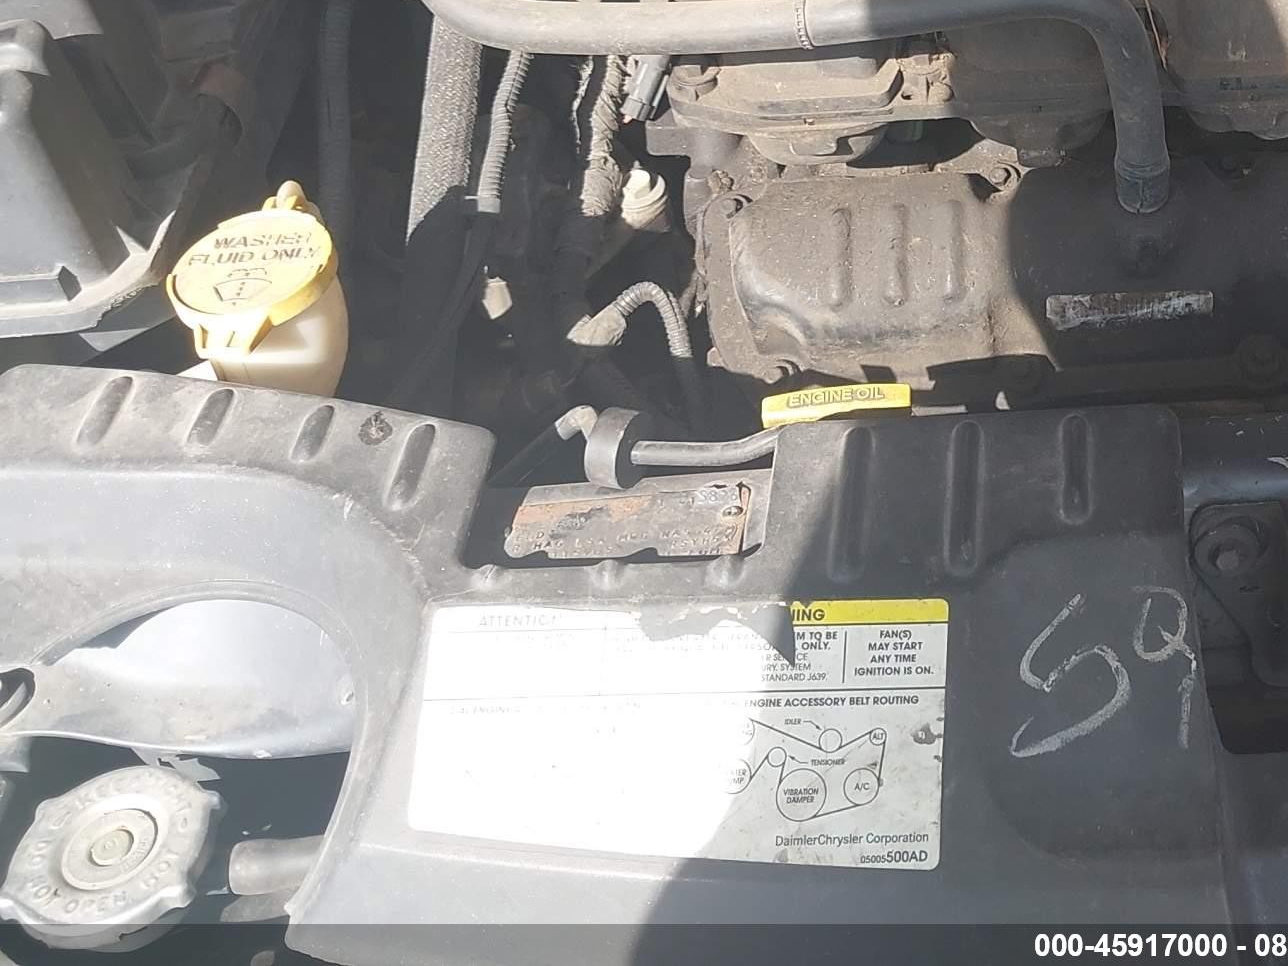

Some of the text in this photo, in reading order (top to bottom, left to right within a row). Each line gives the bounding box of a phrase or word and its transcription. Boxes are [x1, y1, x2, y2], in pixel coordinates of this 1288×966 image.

[214, 232, 312, 250] WASHER
[188, 246, 321, 266] FLUID ONLY
[786, 386, 885, 409] ENGINE OIL
[808, 631, 823, 641] TO
[825, 631, 838, 641] BE
[879, 629, 912, 641] FAN(S)
[801, 641, 831, 651] ONLY.
[868, 640, 923, 651] MAY START
[870, 653, 917, 664] ANY TIME
[854, 665, 935, 677] IGNITION IS ON.
[761, 673, 805, 682] STANDARD
[744, 697, 782, 708] ENGINE
[784, 696, 847, 708] ACCESSORY
[849, 695, 870, 706] BELT
[872, 694, 919, 706] ROUTING
[784, 718, 802, 726] IDLER
[872, 732, 884, 741] ALT
[810, 758, 846, 767] TENSIONER
[783, 787, 819, 796] VIBRATION
[854, 781, 870, 792] A/C
[786, 795, 815, 804] DAMPER
[775, 832, 929, 848] DaimlerChrysler Corporation
[860, 849, 928, 864] 05005500AD
